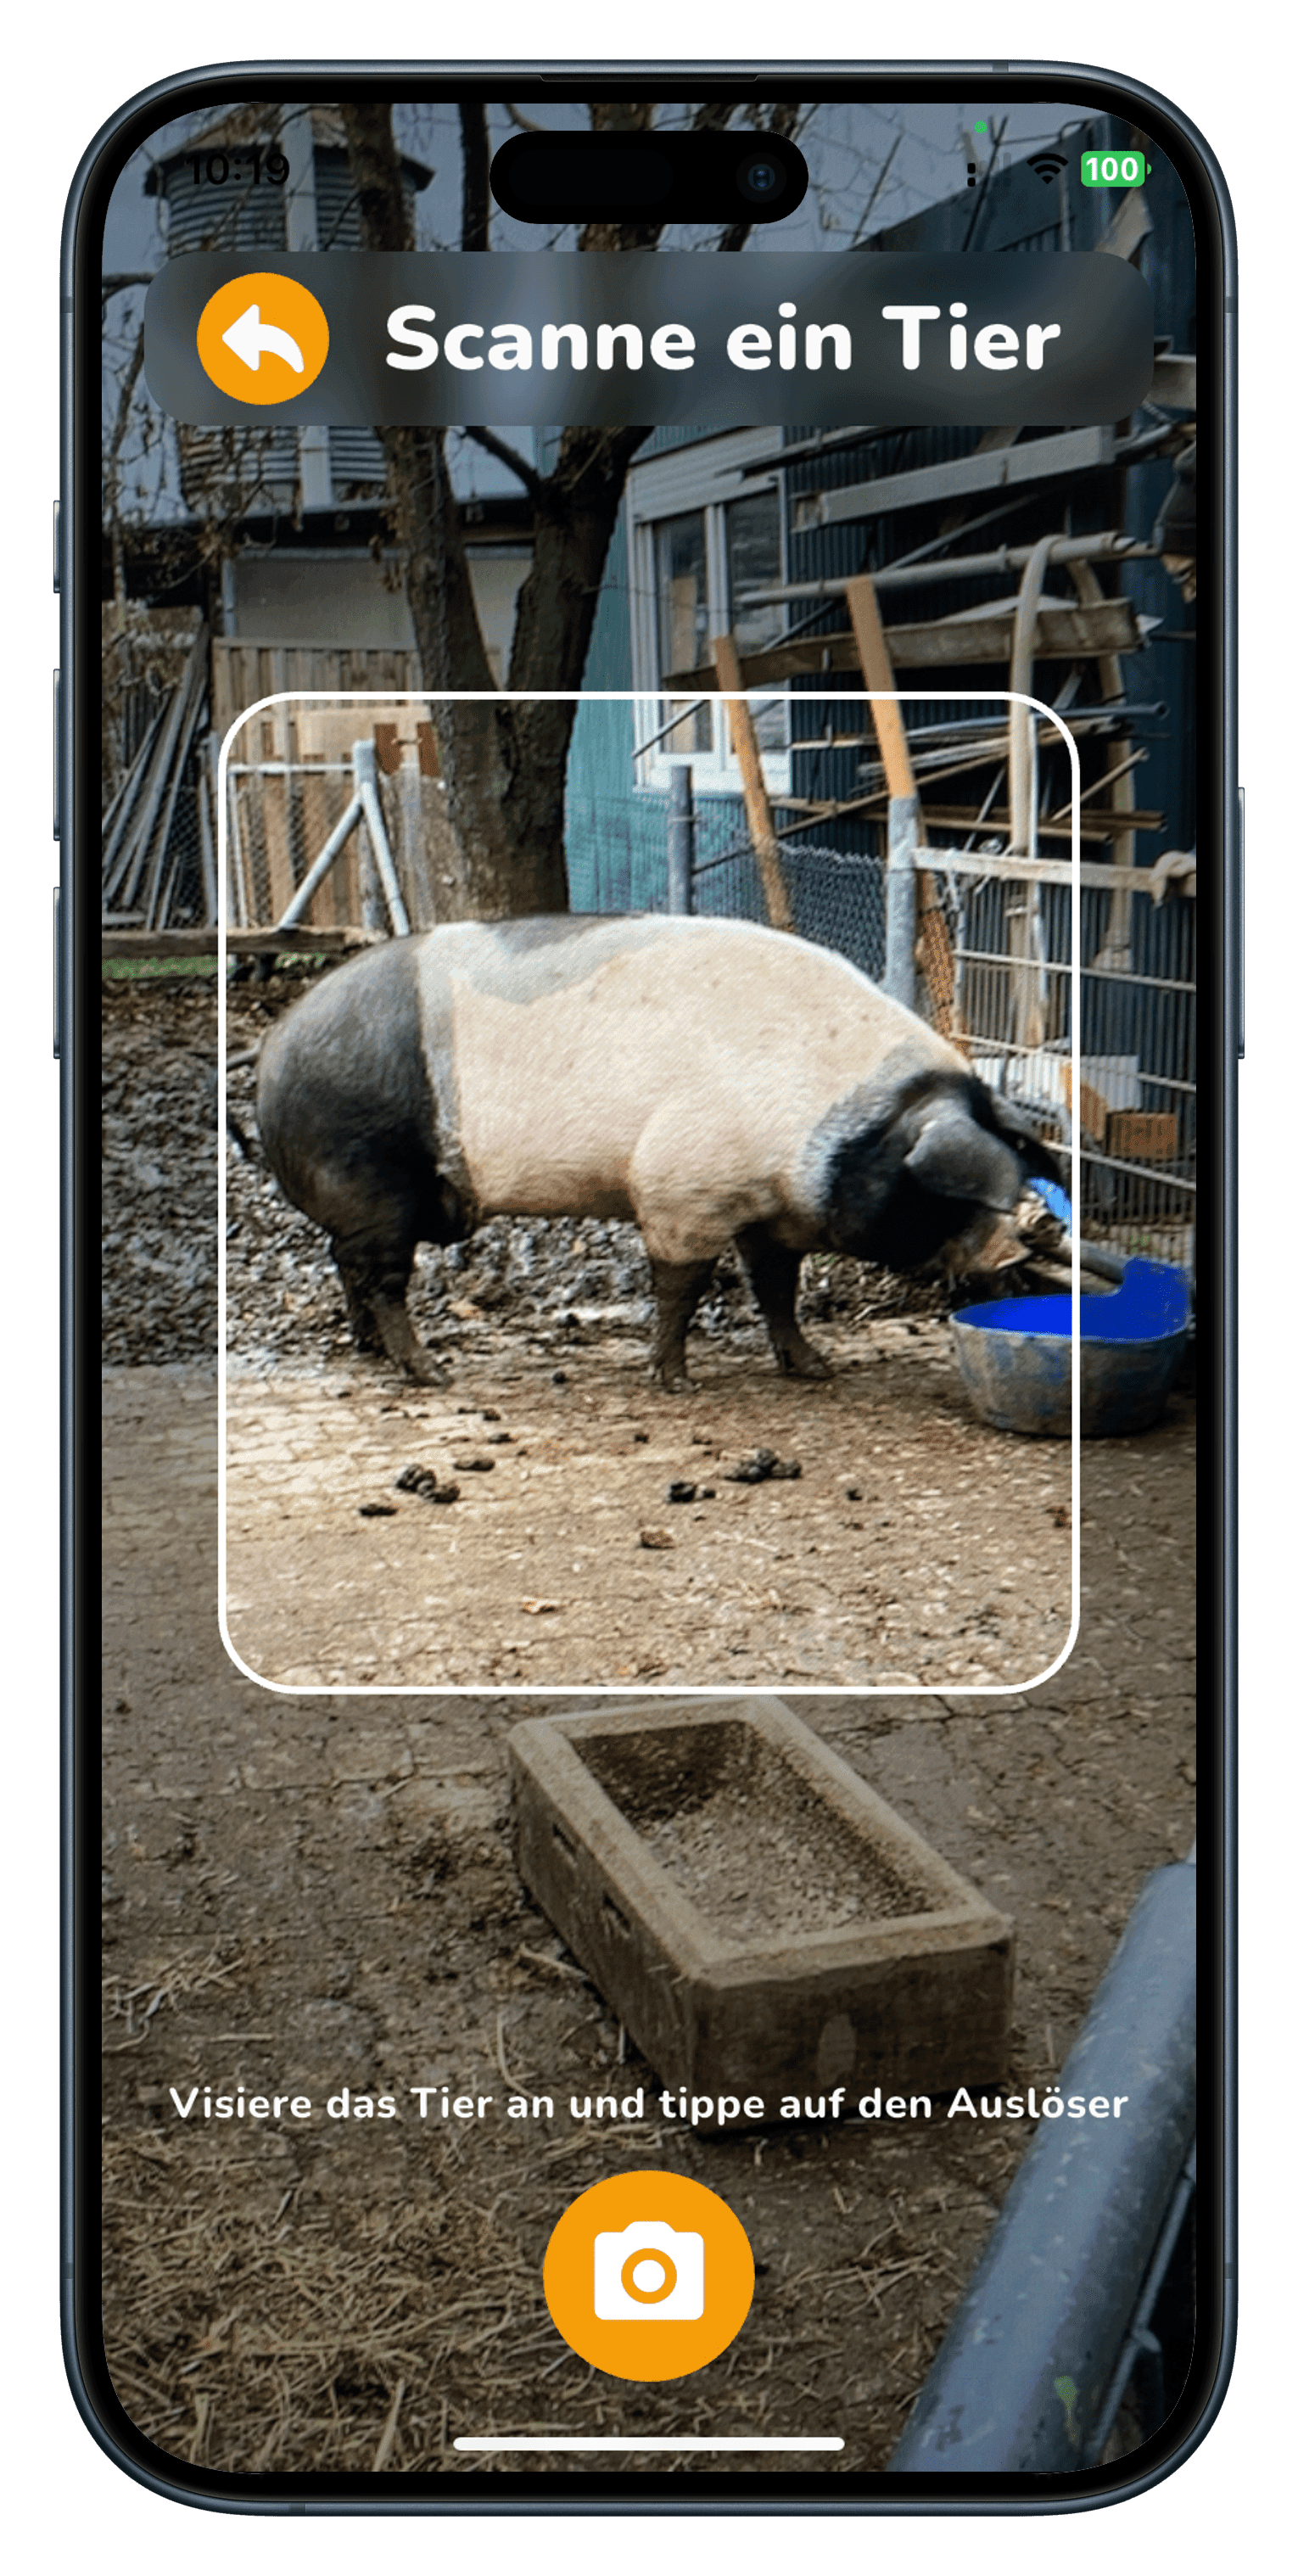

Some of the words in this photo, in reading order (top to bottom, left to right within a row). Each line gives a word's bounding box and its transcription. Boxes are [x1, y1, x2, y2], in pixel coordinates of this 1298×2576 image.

[186, 154, 290, 185] 10:19
[1086, 156, 1139, 182] 100
[386, 305, 696, 371] Scanne
[726, 302, 851, 370] ein
[882, 302, 1060, 370] Tier
[169, 2086, 312, 2119] Visiere
[327, 2087, 396, 2119] das
[410, 2086, 493, 2119] Tier
[506, 2096, 553, 2119] an
[570, 2087, 644, 2119] und
[658, 2086, 765, 2126] tippe
[780, 2086, 845, 2119] auf
[859, 2087, 932, 2119] den
[947, 2086, 1128, 2119] Auslöser
